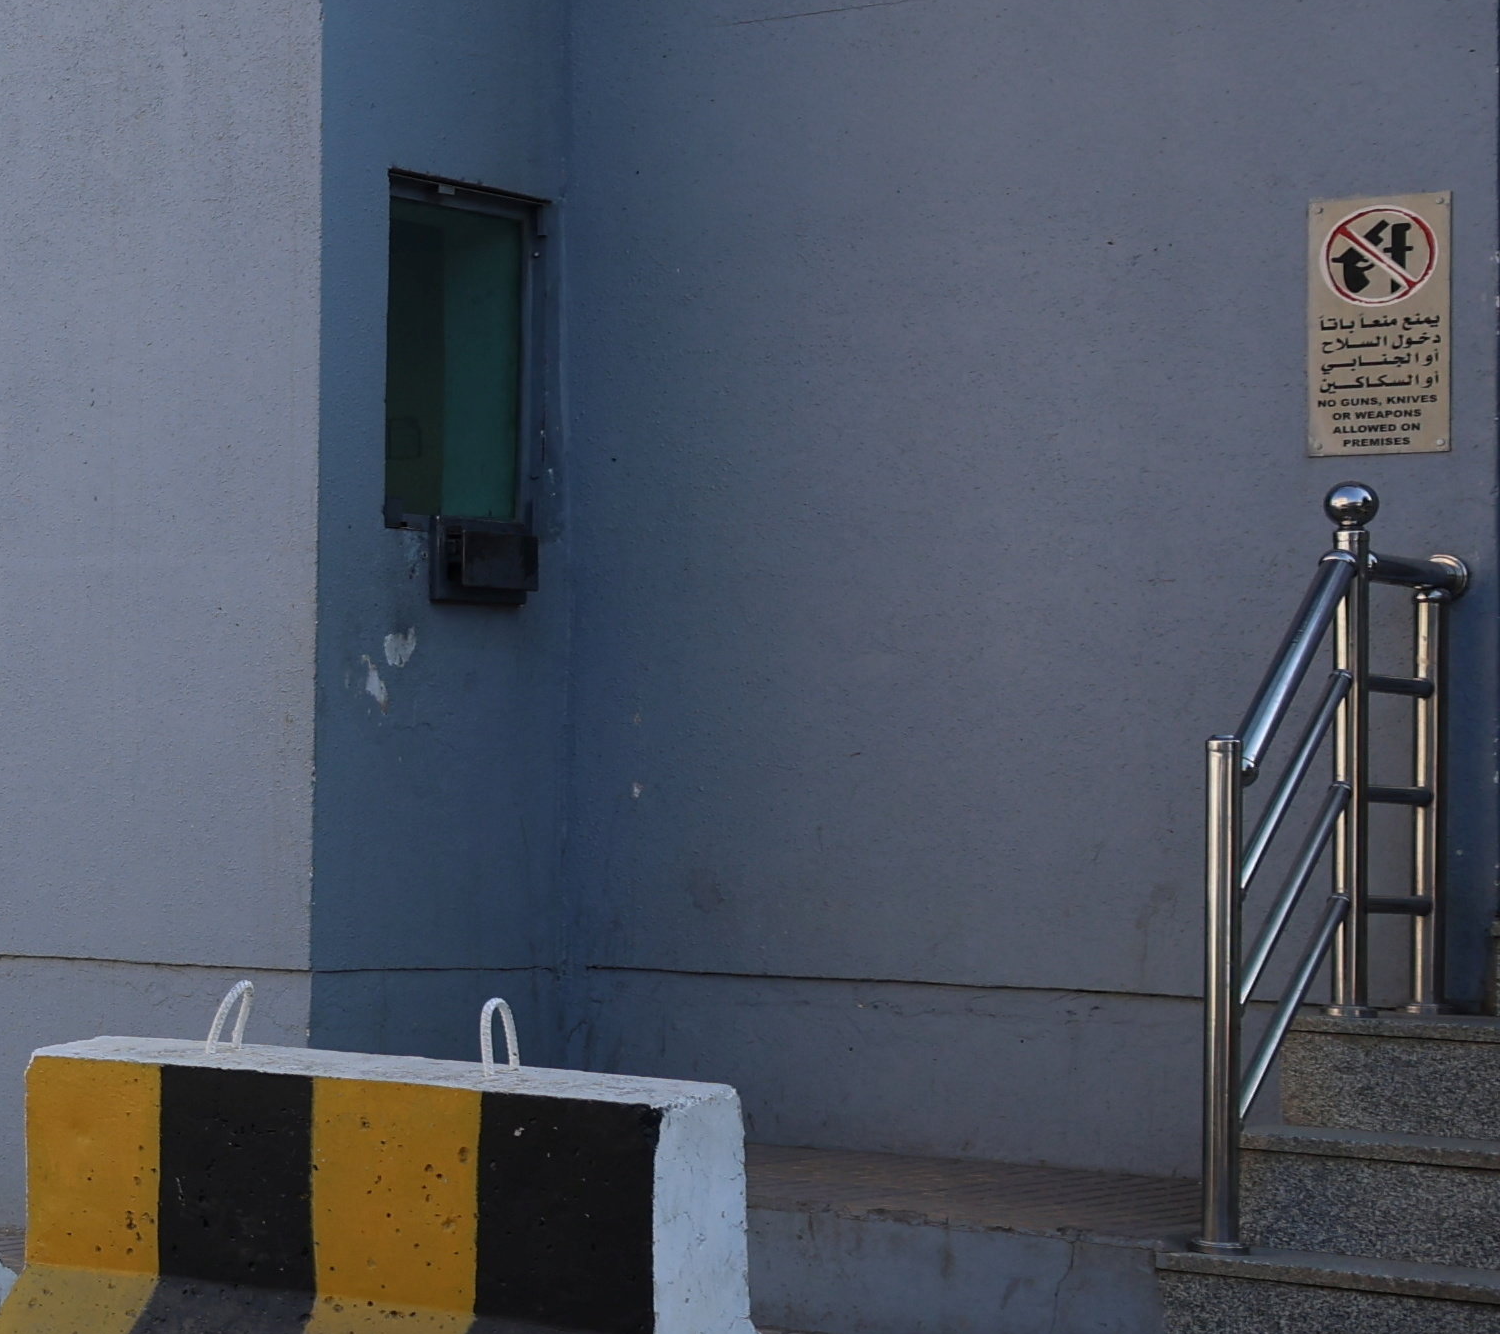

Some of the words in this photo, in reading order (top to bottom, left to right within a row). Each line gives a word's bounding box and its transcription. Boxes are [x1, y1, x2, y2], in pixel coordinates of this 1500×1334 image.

[1402, 313, 1440, 330] يمنع
[1322, 334, 1387, 354] السلاح
[1392, 332, 1441, 349] دخول
[1320, 374, 1419, 394] السكاكين
[1317, 399, 1337, 408] NO
[1340, 397, 1382, 407] GUNS,
[1386, 394, 1438, 405] KNIVES
[1332, 412, 1351, 421] OR
[1355, 409, 1422, 420] WEAPONS
[1332, 423, 1397, 434] ALLOWED
[1401, 423, 1421, 431] ON
[1343, 437, 1411, 447] PREMISES
